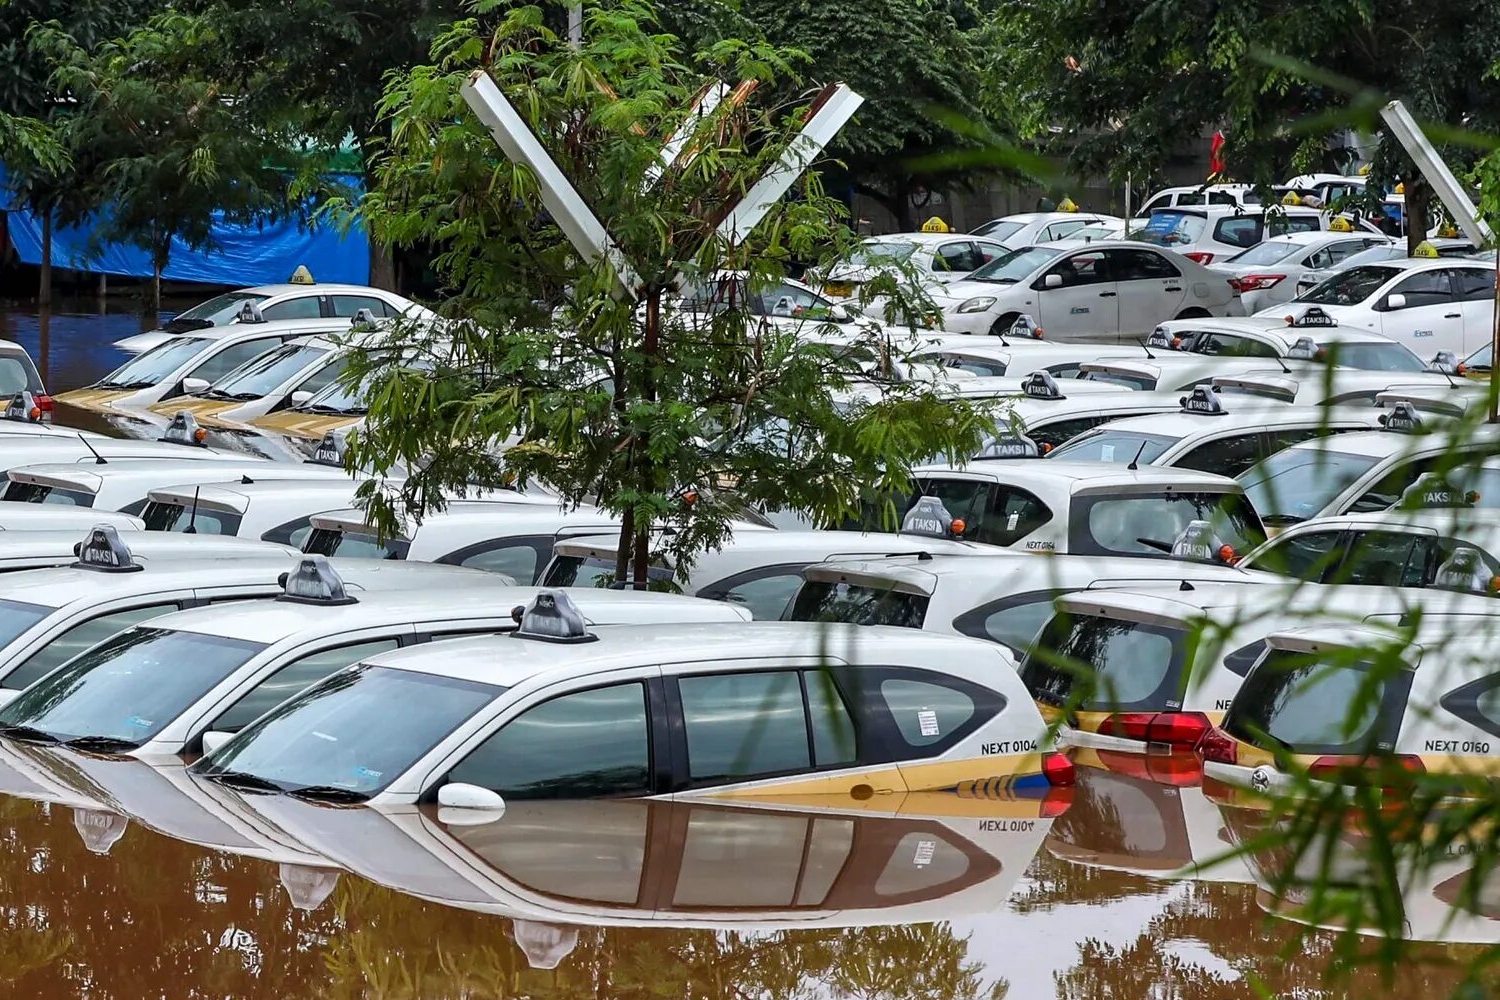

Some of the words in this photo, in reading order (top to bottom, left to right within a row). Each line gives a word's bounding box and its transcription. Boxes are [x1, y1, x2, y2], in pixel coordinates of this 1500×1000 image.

[1306, 316, 1325, 324] TAKSI
[320, 449, 336, 460] TAKSI
[996, 444, 1025, 455] TAKSI
[914, 518, 936, 531] TAKSI
[1026, 541, 1041, 549] NEXT
[1183, 543, 1205, 557] TAKSI
[91, 548, 112, 563] TAKSI
[1215, 700, 1232, 710] NE
[982, 742, 1010, 755] NEXT
[1013, 740, 1038, 752] 0104
[1425, 741, 1459, 752] NEXT
[1462, 741, 1490, 754] 0160
